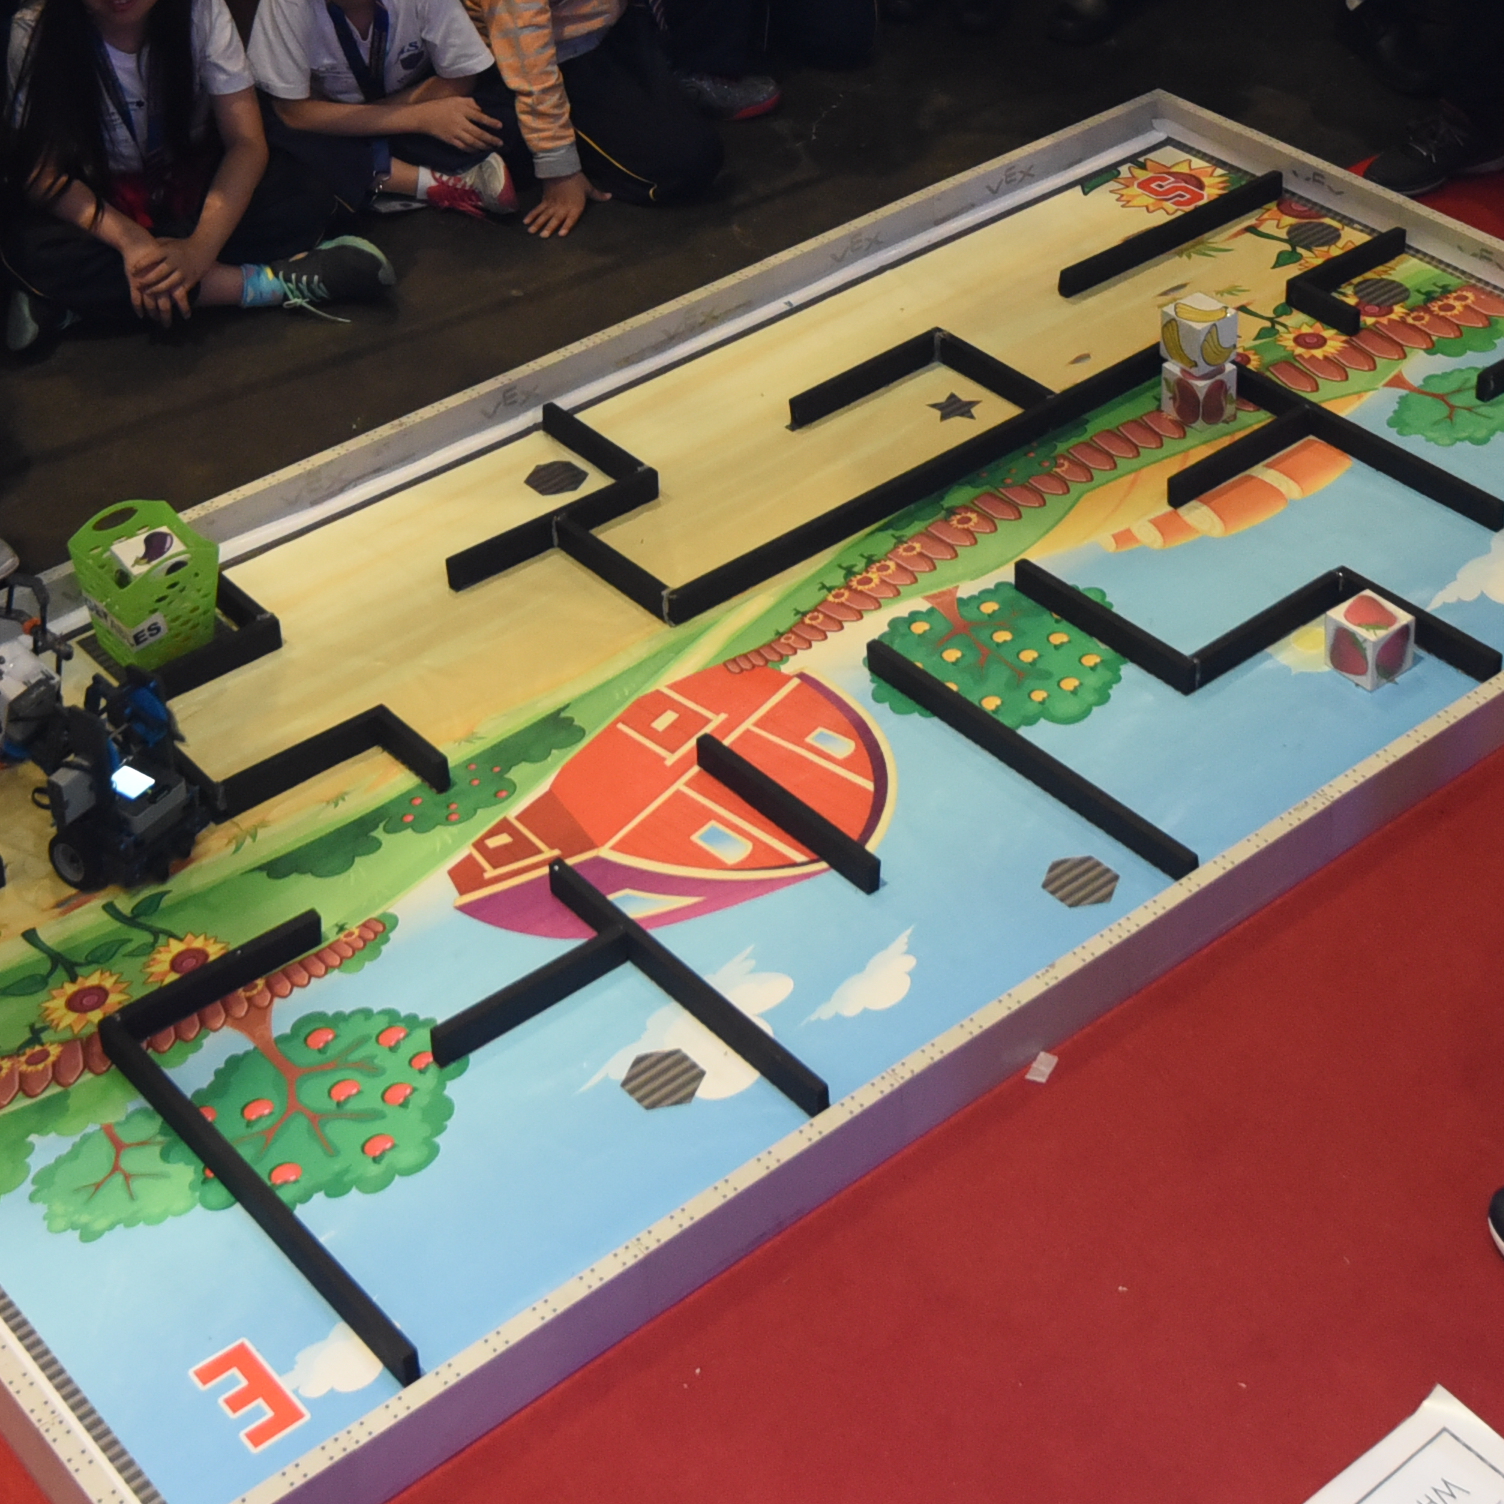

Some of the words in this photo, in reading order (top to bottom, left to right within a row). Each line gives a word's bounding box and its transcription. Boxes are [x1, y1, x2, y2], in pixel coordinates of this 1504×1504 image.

[985, 164, 1039, 195] VEX
[1135, 171, 1207, 208] S
[186, 1335, 311, 1457] E
